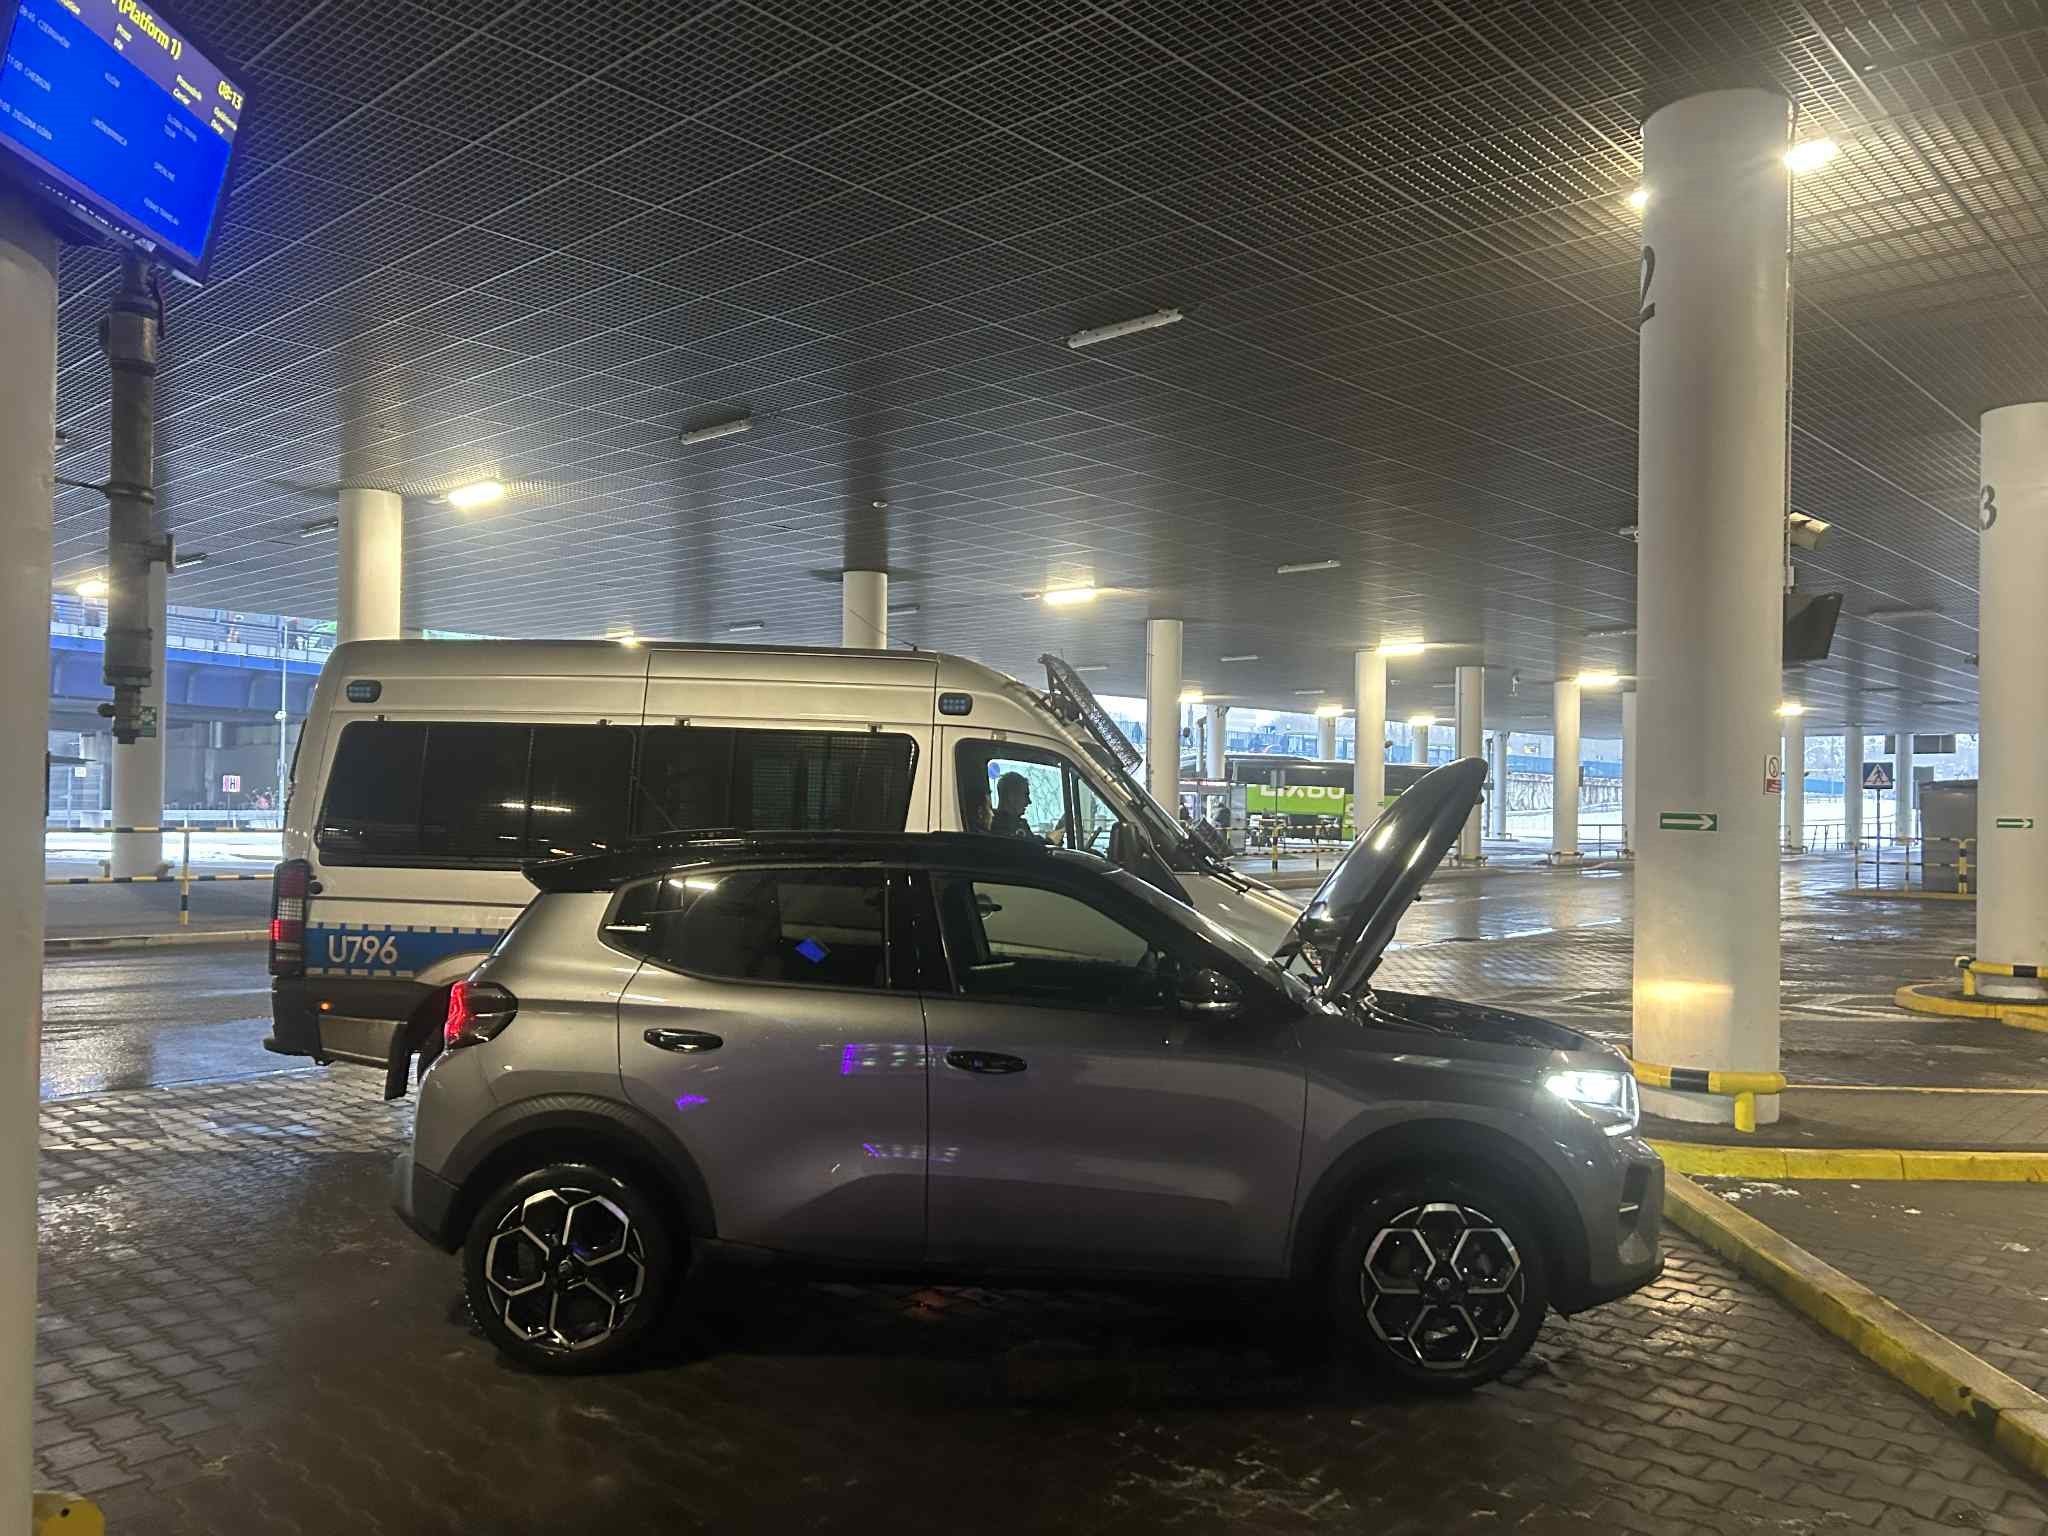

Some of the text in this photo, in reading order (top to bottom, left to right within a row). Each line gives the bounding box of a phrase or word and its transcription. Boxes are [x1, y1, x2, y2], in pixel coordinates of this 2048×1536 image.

[118, 0, 170, 50] (Platform
[170, 38, 182, 60] 1)
[1640, 245, 1656, 329] 2
[1980, 484, 1998, 530] 3
[328, 934, 398, 965] U796
